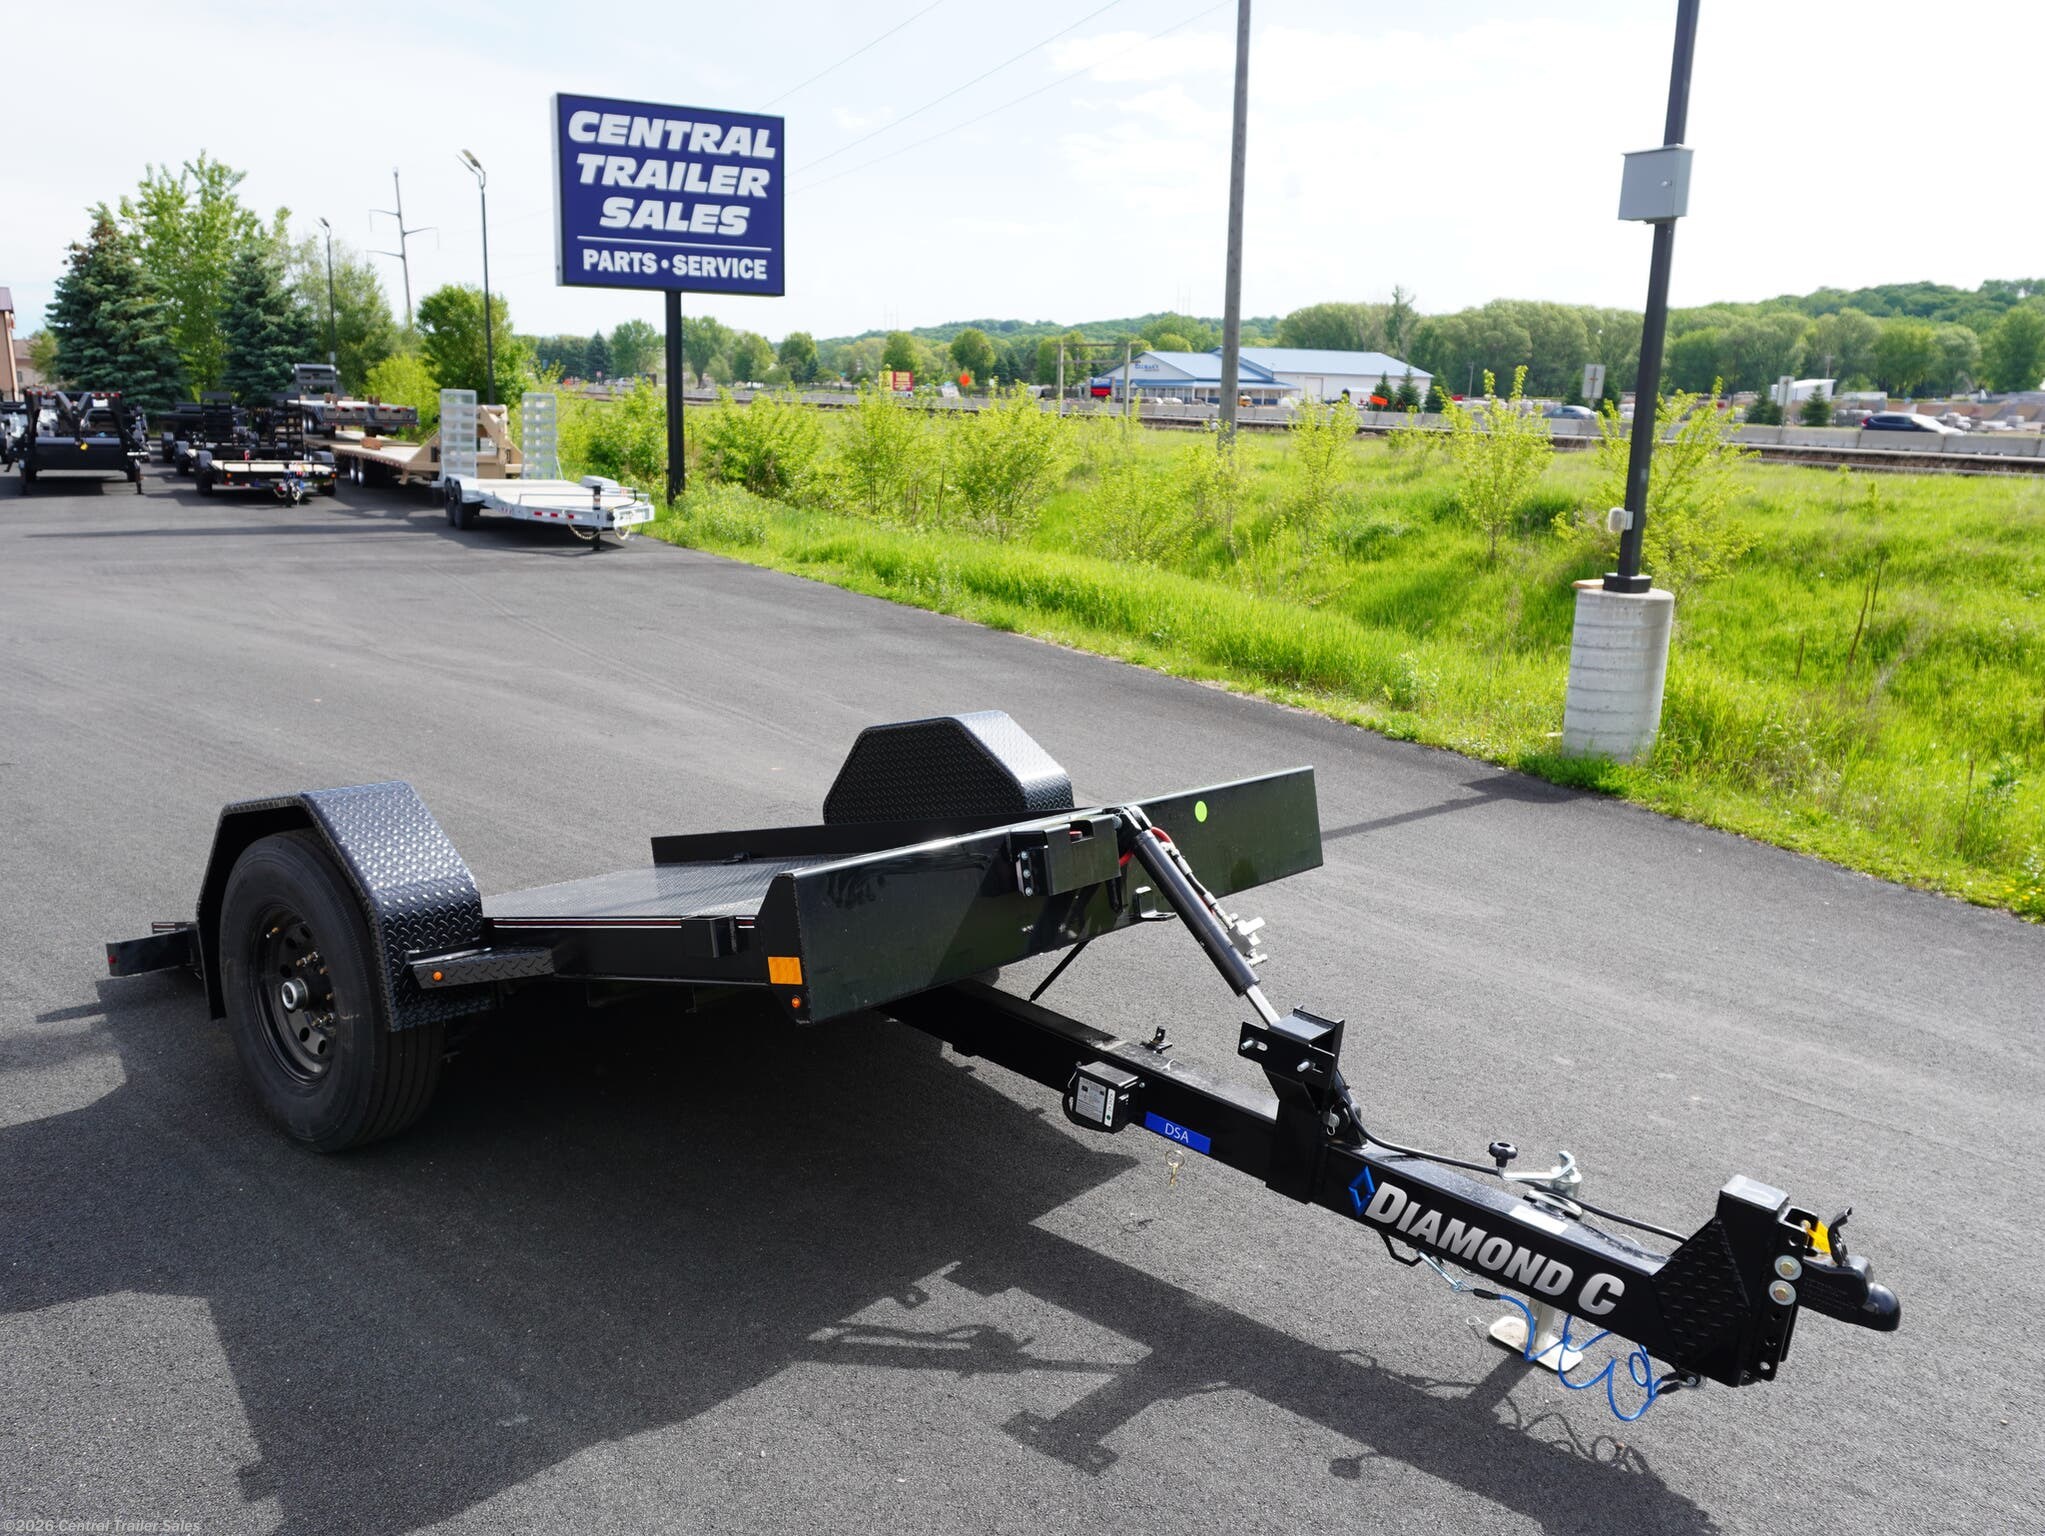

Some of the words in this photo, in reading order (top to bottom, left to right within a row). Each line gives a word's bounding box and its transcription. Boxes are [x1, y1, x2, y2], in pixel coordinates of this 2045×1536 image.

[568, 110, 776, 159] CENTRAL
[576, 152, 771, 198] TRAILER
[599, 196, 751, 236] SALES
[583, 248, 658, 275] PARTS
[672, 254, 768, 280] SERVICE
[1164, 1122, 1189, 1144] DSA
[1364, 1181, 1574, 1297] DIAMOND
[1577, 1272, 1626, 1316] C
